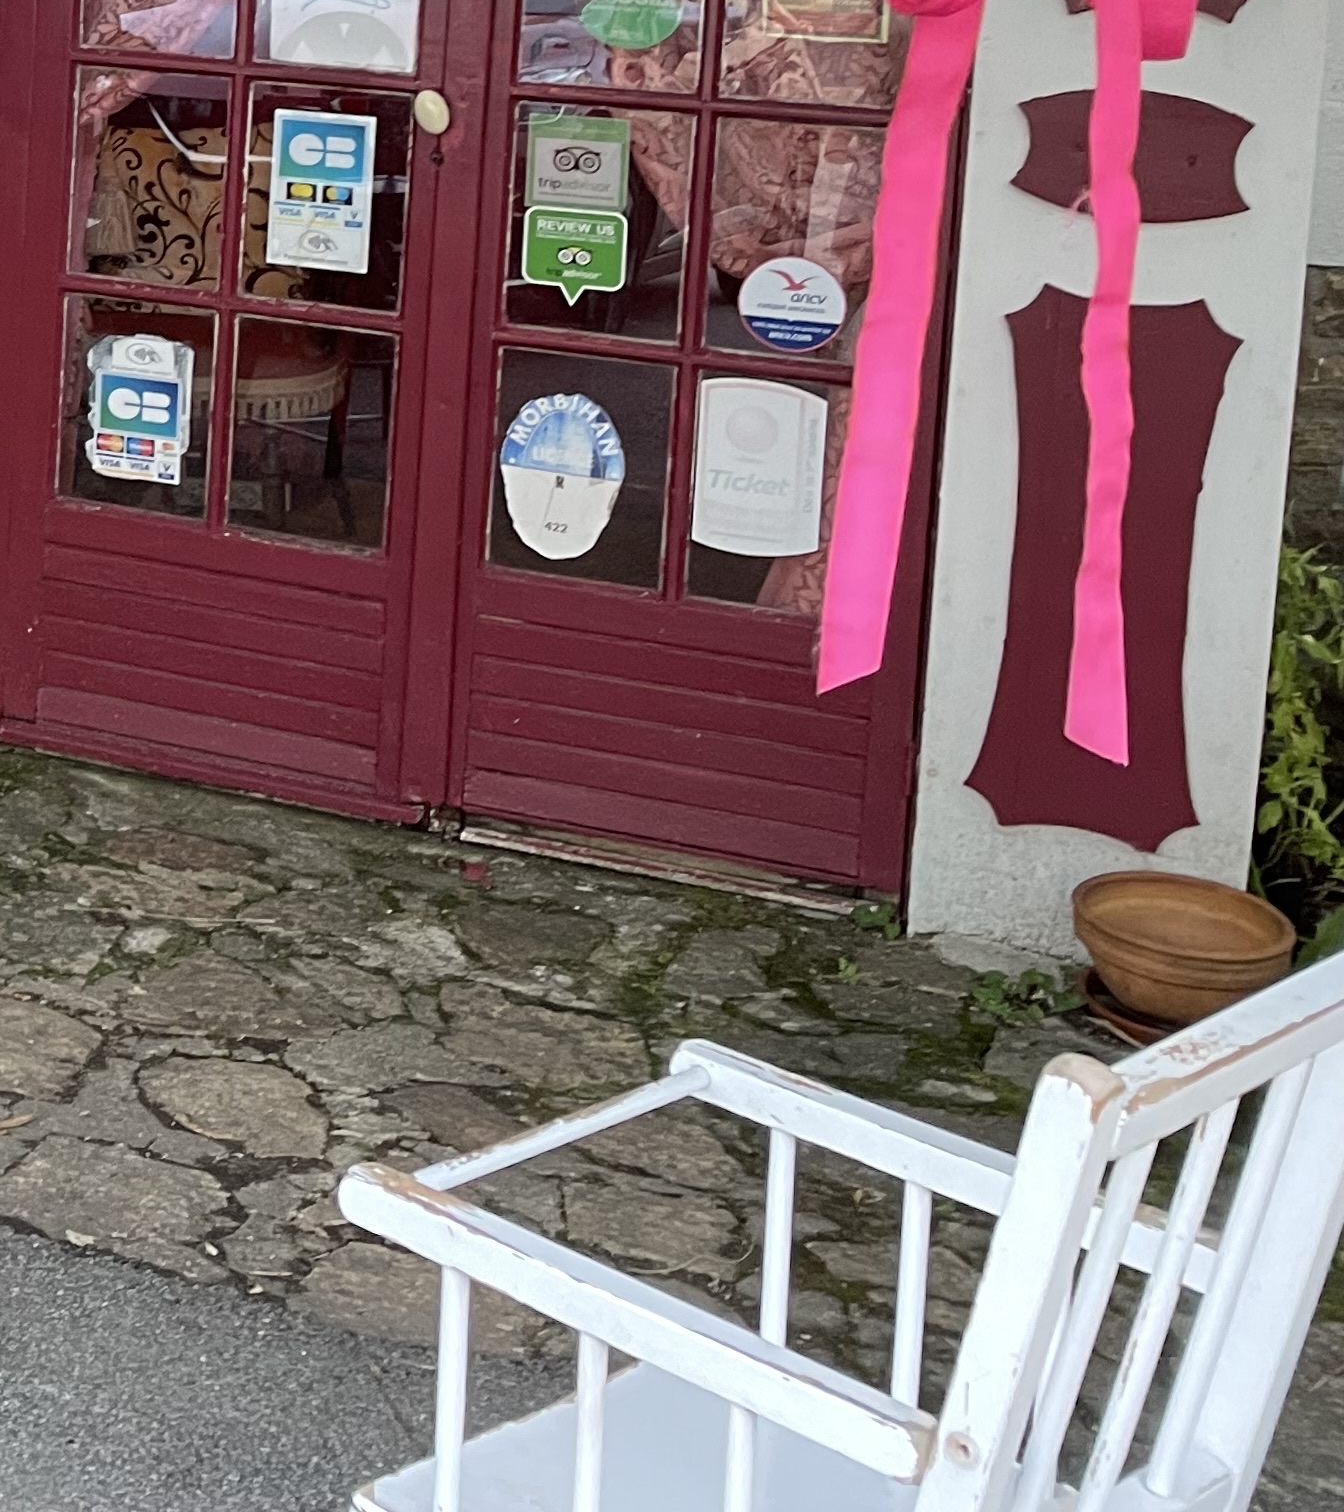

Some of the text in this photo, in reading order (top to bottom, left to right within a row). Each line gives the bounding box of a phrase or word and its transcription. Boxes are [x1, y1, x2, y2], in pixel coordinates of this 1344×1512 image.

[538, 177, 611, 193] tripadvisor
[537, 219, 615, 236] REVIEW US
[791, 293, 828, 305] ancv
[509, 393, 619, 456] MORBIHAN
[100, 458, 150, 472] VISA VISA
[709, 469, 791, 497] Ticket
[544, 521, 569, 533] 422
